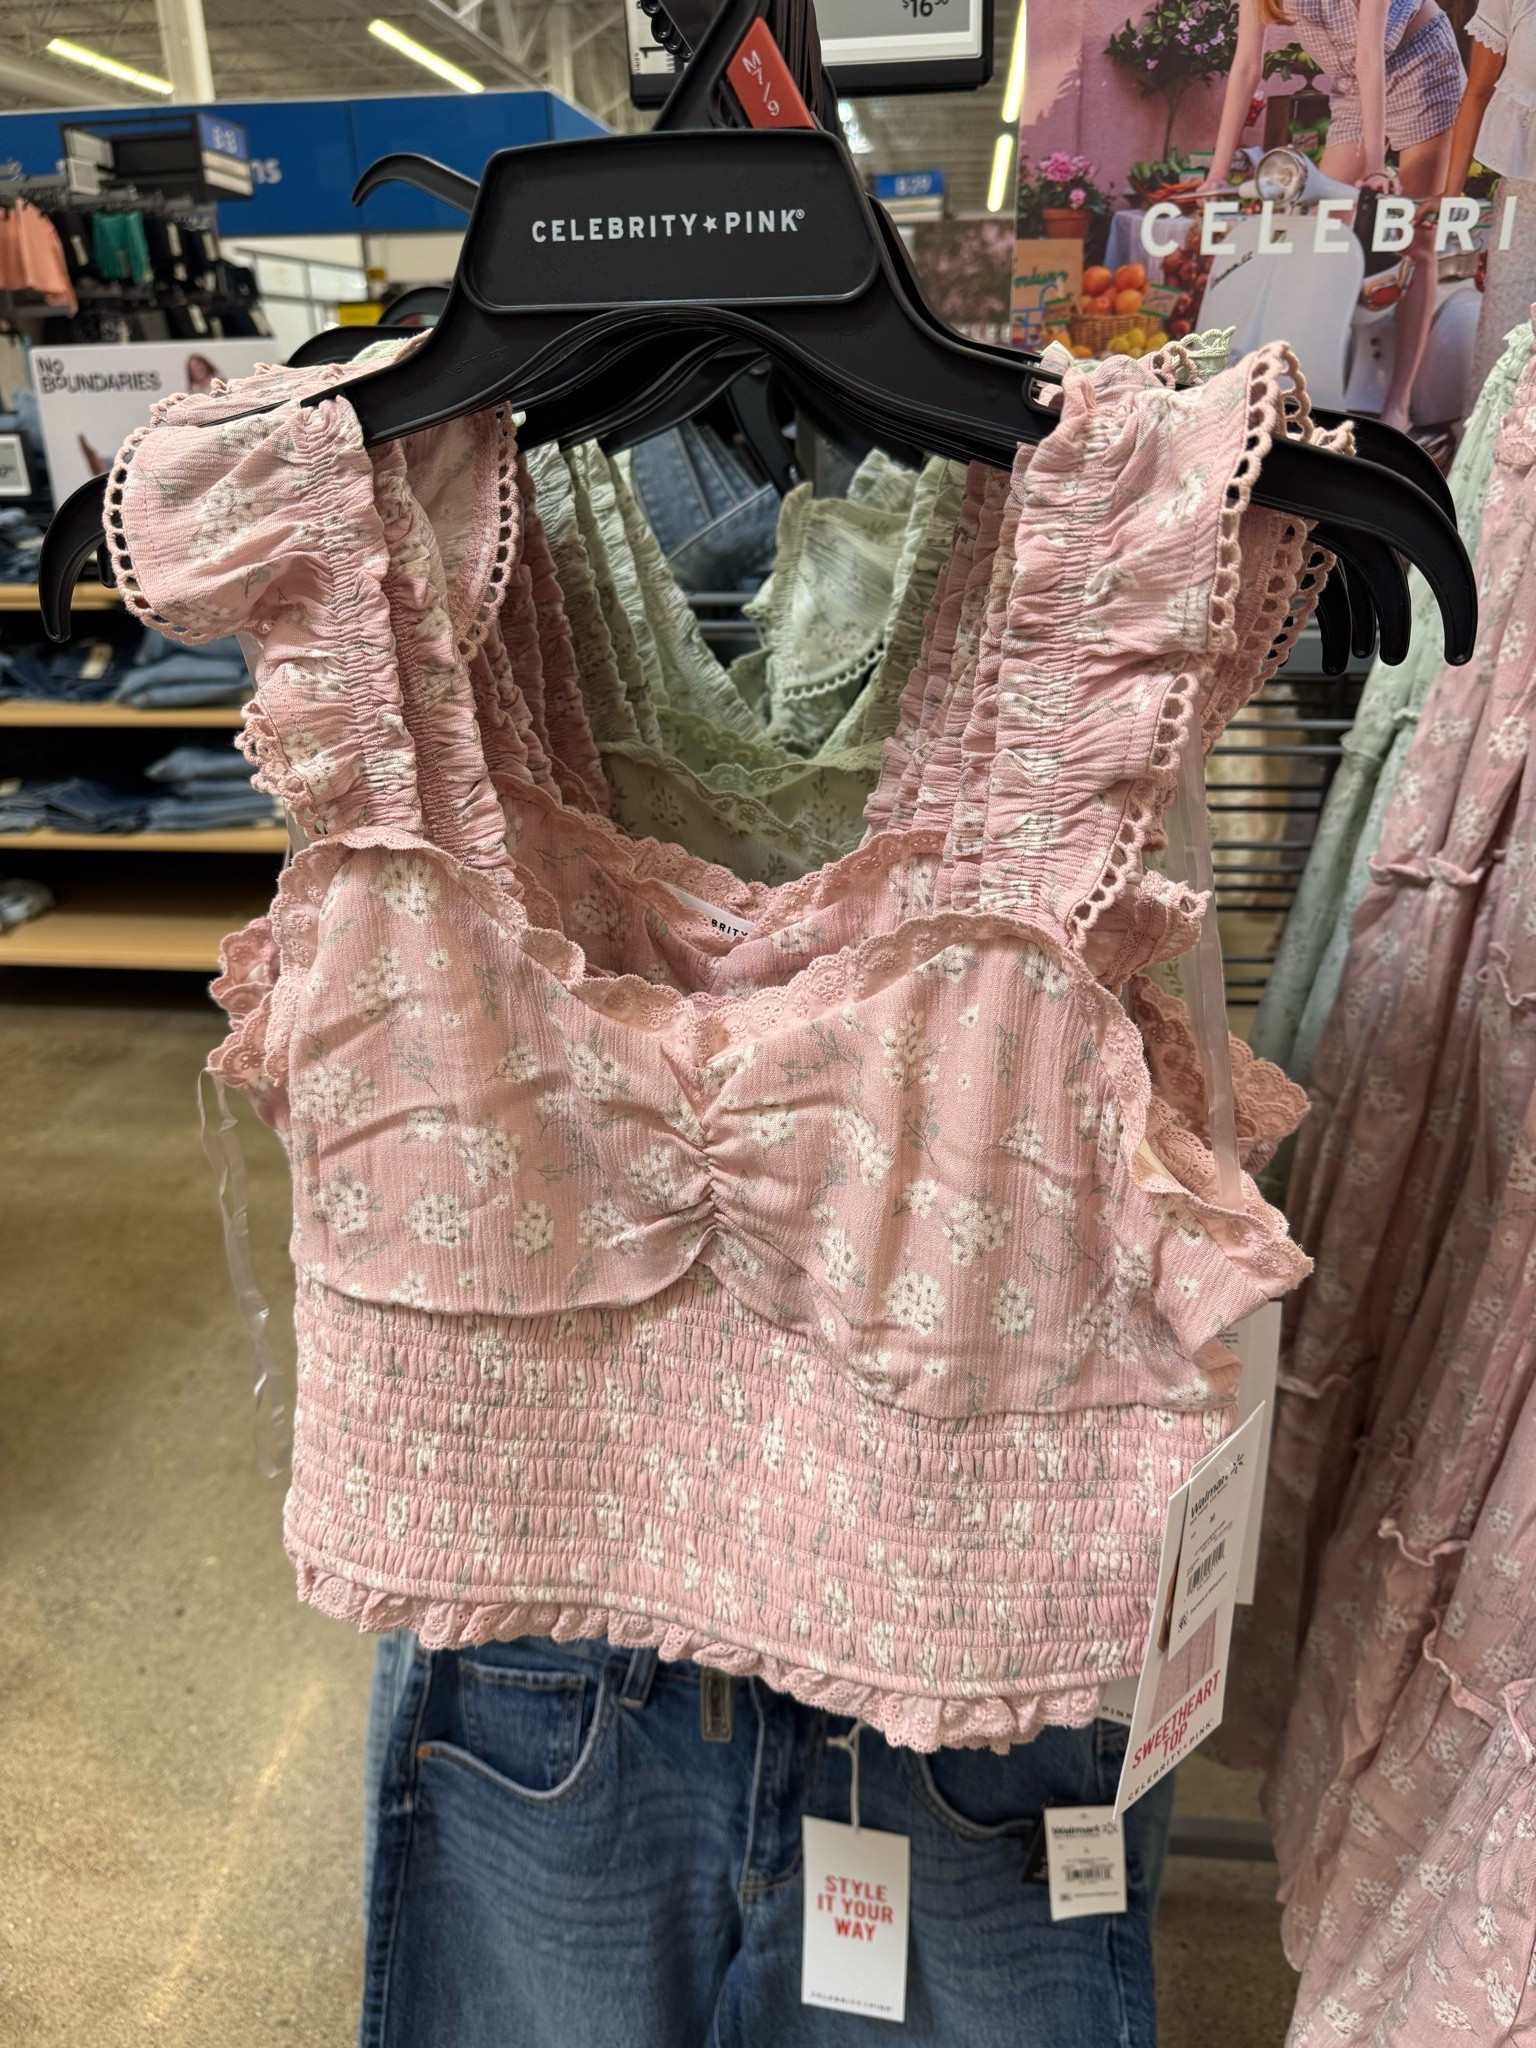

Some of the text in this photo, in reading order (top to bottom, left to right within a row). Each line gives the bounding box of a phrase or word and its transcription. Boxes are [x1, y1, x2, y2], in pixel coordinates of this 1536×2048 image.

[742, 50, 761, 73] M
[531, 213, 698, 243] CELEBRITY
[1140, 195, 1518, 258] CELEBRI
[1132, 1669, 1221, 1770] SWEETHEART
[1162, 1721, 1188, 1758] TOP
[1127, 1748, 1182, 1801] CELEBRITY
[825, 1874, 888, 1902] STYLE
[817, 1892, 894, 1924] IT YOUR
[834, 1916, 876, 1942] WAY
